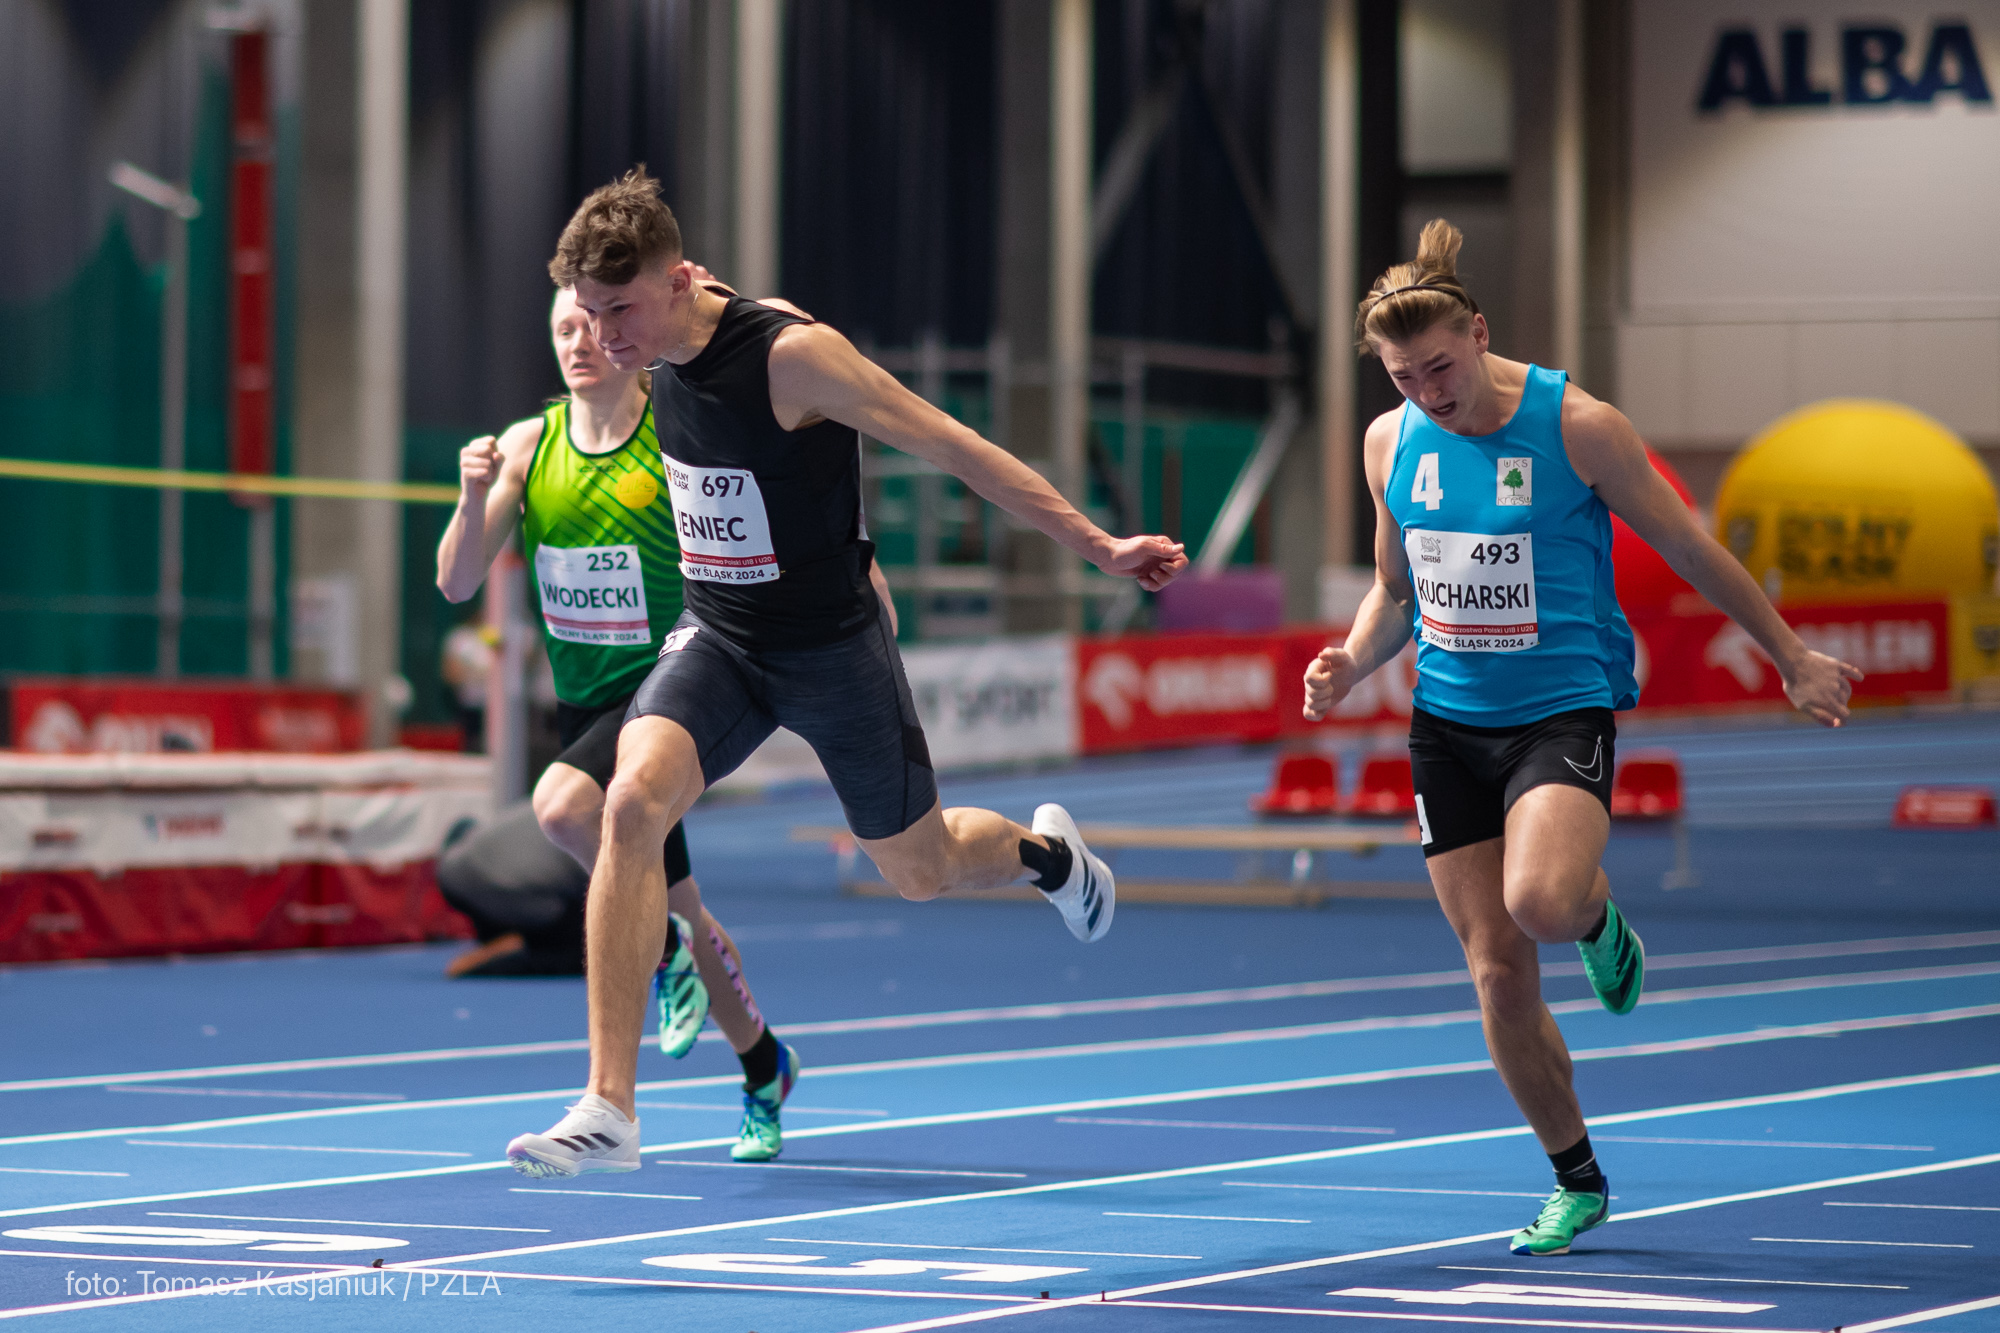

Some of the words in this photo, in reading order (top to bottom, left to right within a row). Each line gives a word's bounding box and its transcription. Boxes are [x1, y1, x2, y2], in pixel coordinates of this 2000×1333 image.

[1697, 25, 1995, 112] ALBA
[701, 475, 745, 498] 697
[1411, 452, 1443, 511] 4
[586, 551, 630, 572] 252
[758, 556, 772, 564] U20
[1470, 542, 1520, 565] 493
[703, 566, 733, 581] ŚLĄSK
[735, 569, 765, 580] 2024
[542, 581, 639, 609] WODECKI
[1417, 576, 1530, 610] KUCHARSKI
[613, 633, 638, 641] 2024
[1430, 631, 1452, 647] DOLNY
[1454, 636, 1492, 650] ŚLĄSK
[1494, 638, 1525, 648] 2024
[1444, 625, 1483, 634] Mistrzostwa
[1483, 626, 1503, 634] Polski
[1504, 626, 1516, 634] U18
[1520, 625, 1534, 633] U20
